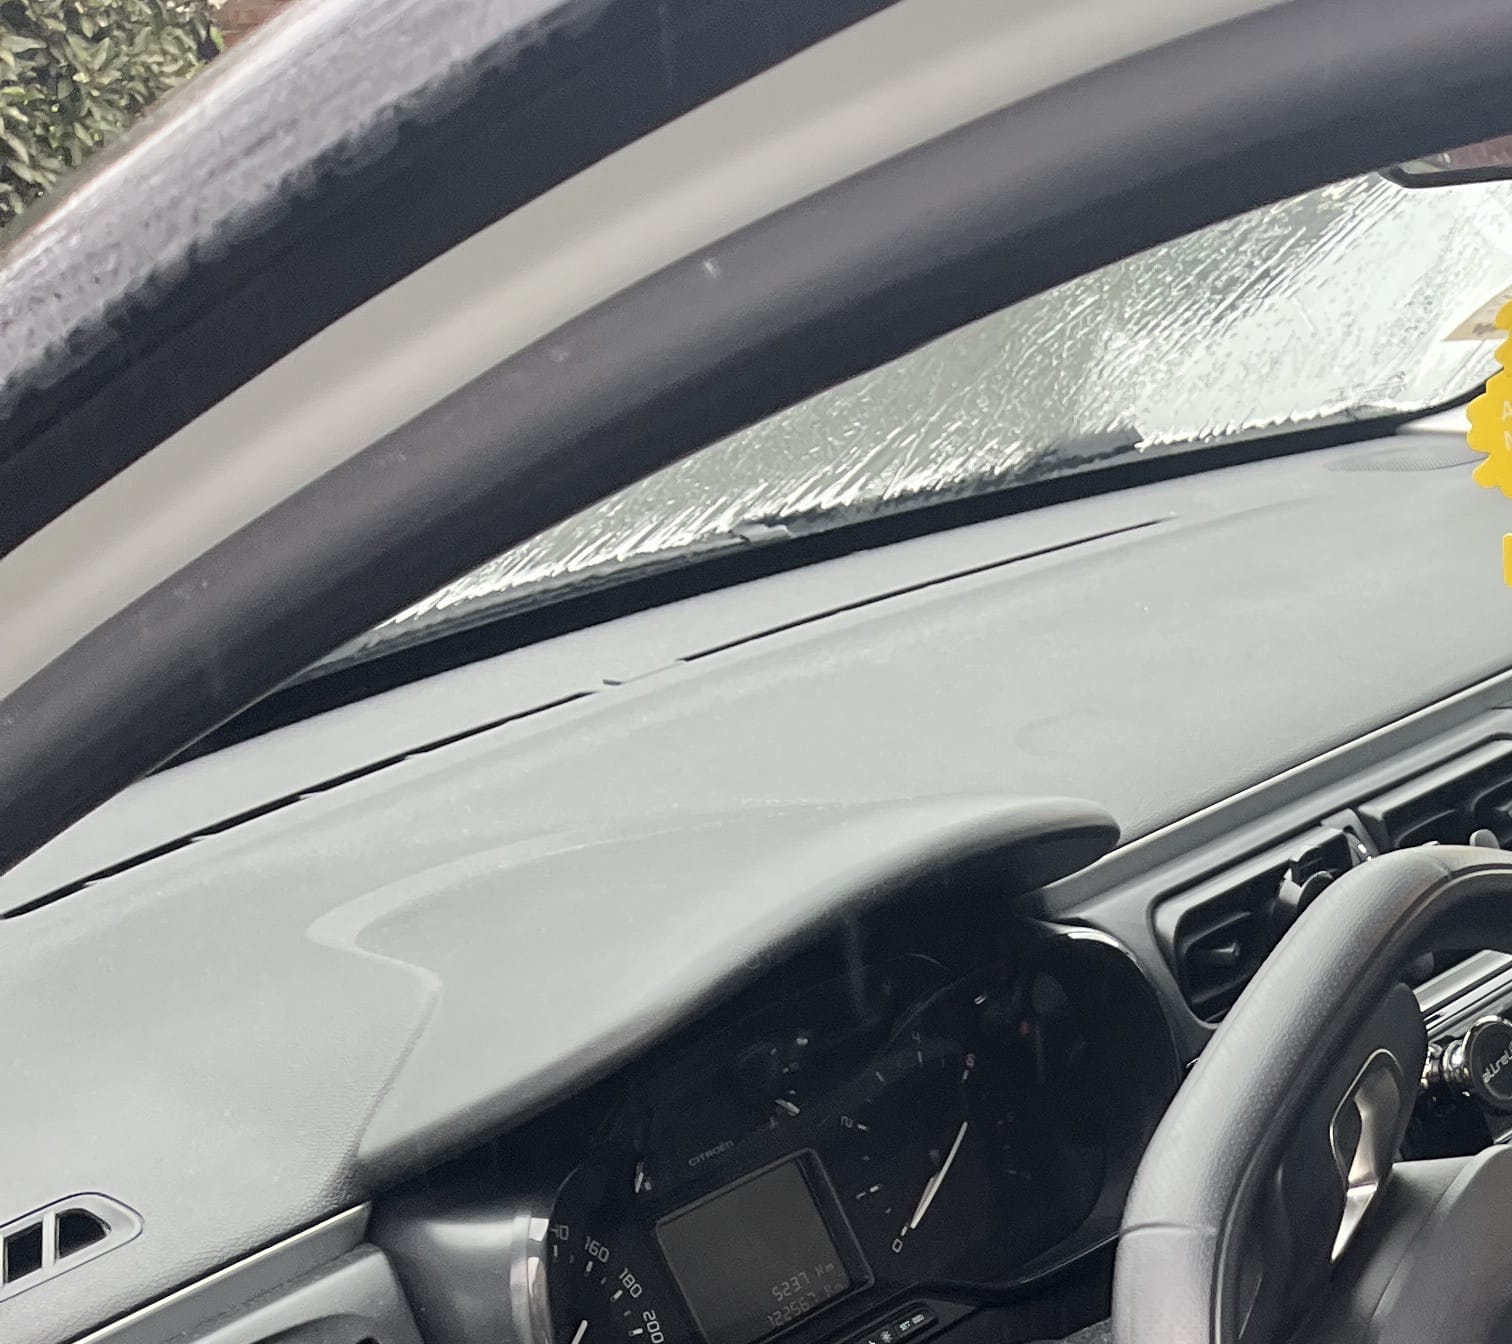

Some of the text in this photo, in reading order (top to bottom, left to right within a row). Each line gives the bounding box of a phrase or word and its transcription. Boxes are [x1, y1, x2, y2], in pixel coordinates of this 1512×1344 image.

[585, 1236, 610, 1263] 160
[619, 1267, 642, 1299] 180
[643, 1309, 664, 1344] 200
